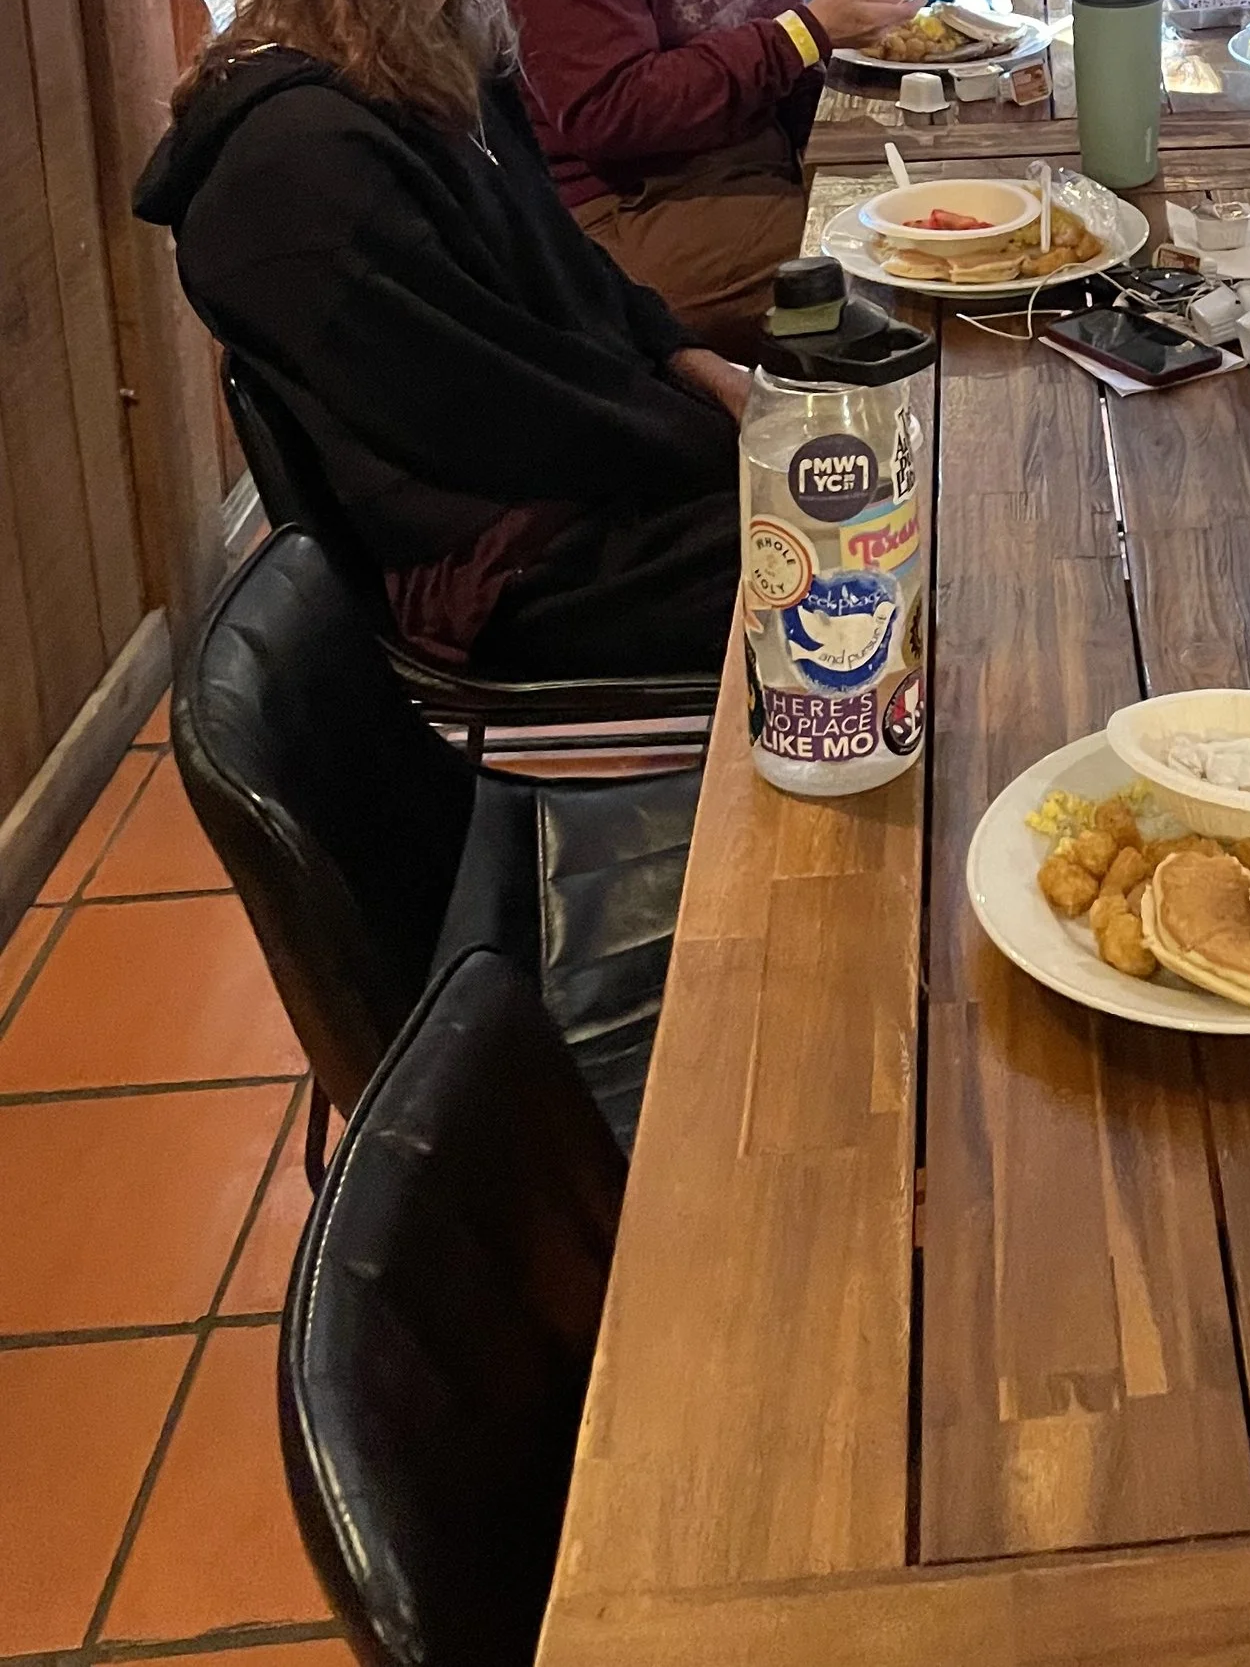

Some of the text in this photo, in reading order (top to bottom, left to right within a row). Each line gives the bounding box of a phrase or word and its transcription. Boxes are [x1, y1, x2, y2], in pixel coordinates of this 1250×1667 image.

[756, 537, 797, 566] WHOLE
[754, 568, 785, 595] HOLY
[818, 649, 845, 665] and
[797, 710, 873, 736] PLACE
[763, 730, 874, 758] LIKE MO
